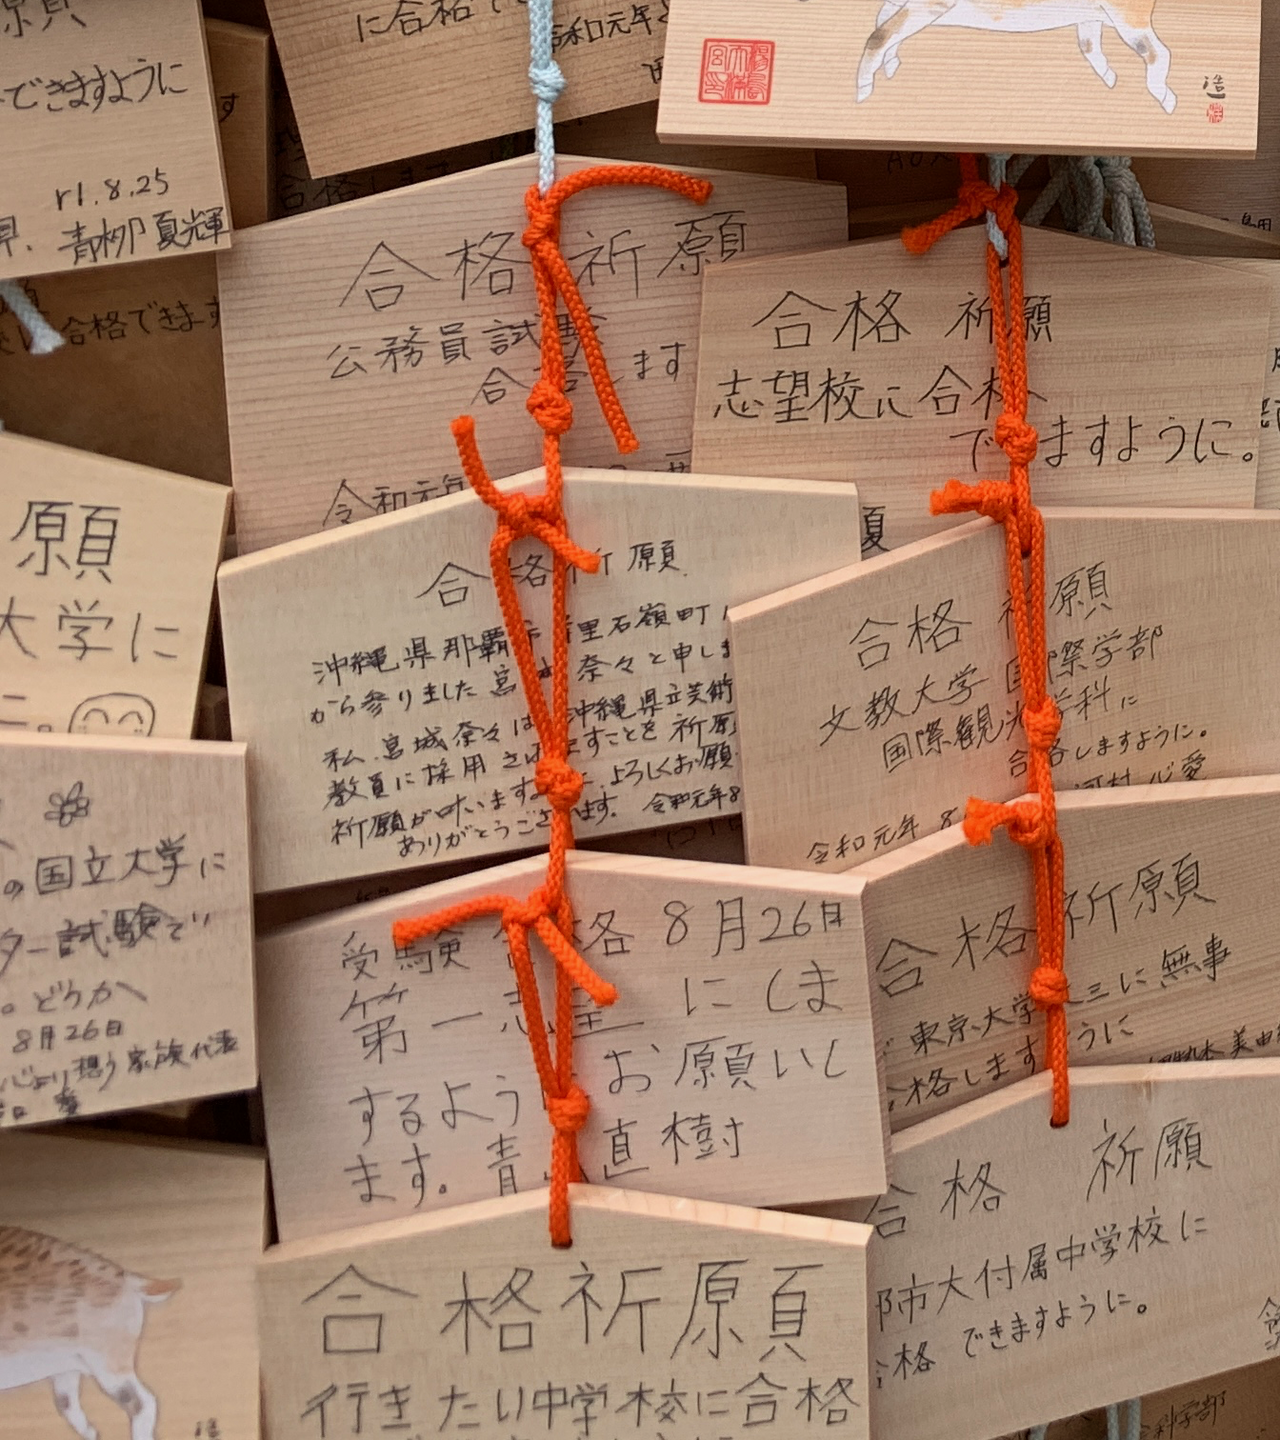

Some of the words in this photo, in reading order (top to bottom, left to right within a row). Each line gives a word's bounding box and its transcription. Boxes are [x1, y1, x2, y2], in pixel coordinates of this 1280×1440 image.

[338, 210, 749, 313] 合格祈願
[713, 364, 1049, 426] 志望校に合
[949, 415, 1257, 472] でますように。
[302, 1260, 826, 1362] 合格祈願
